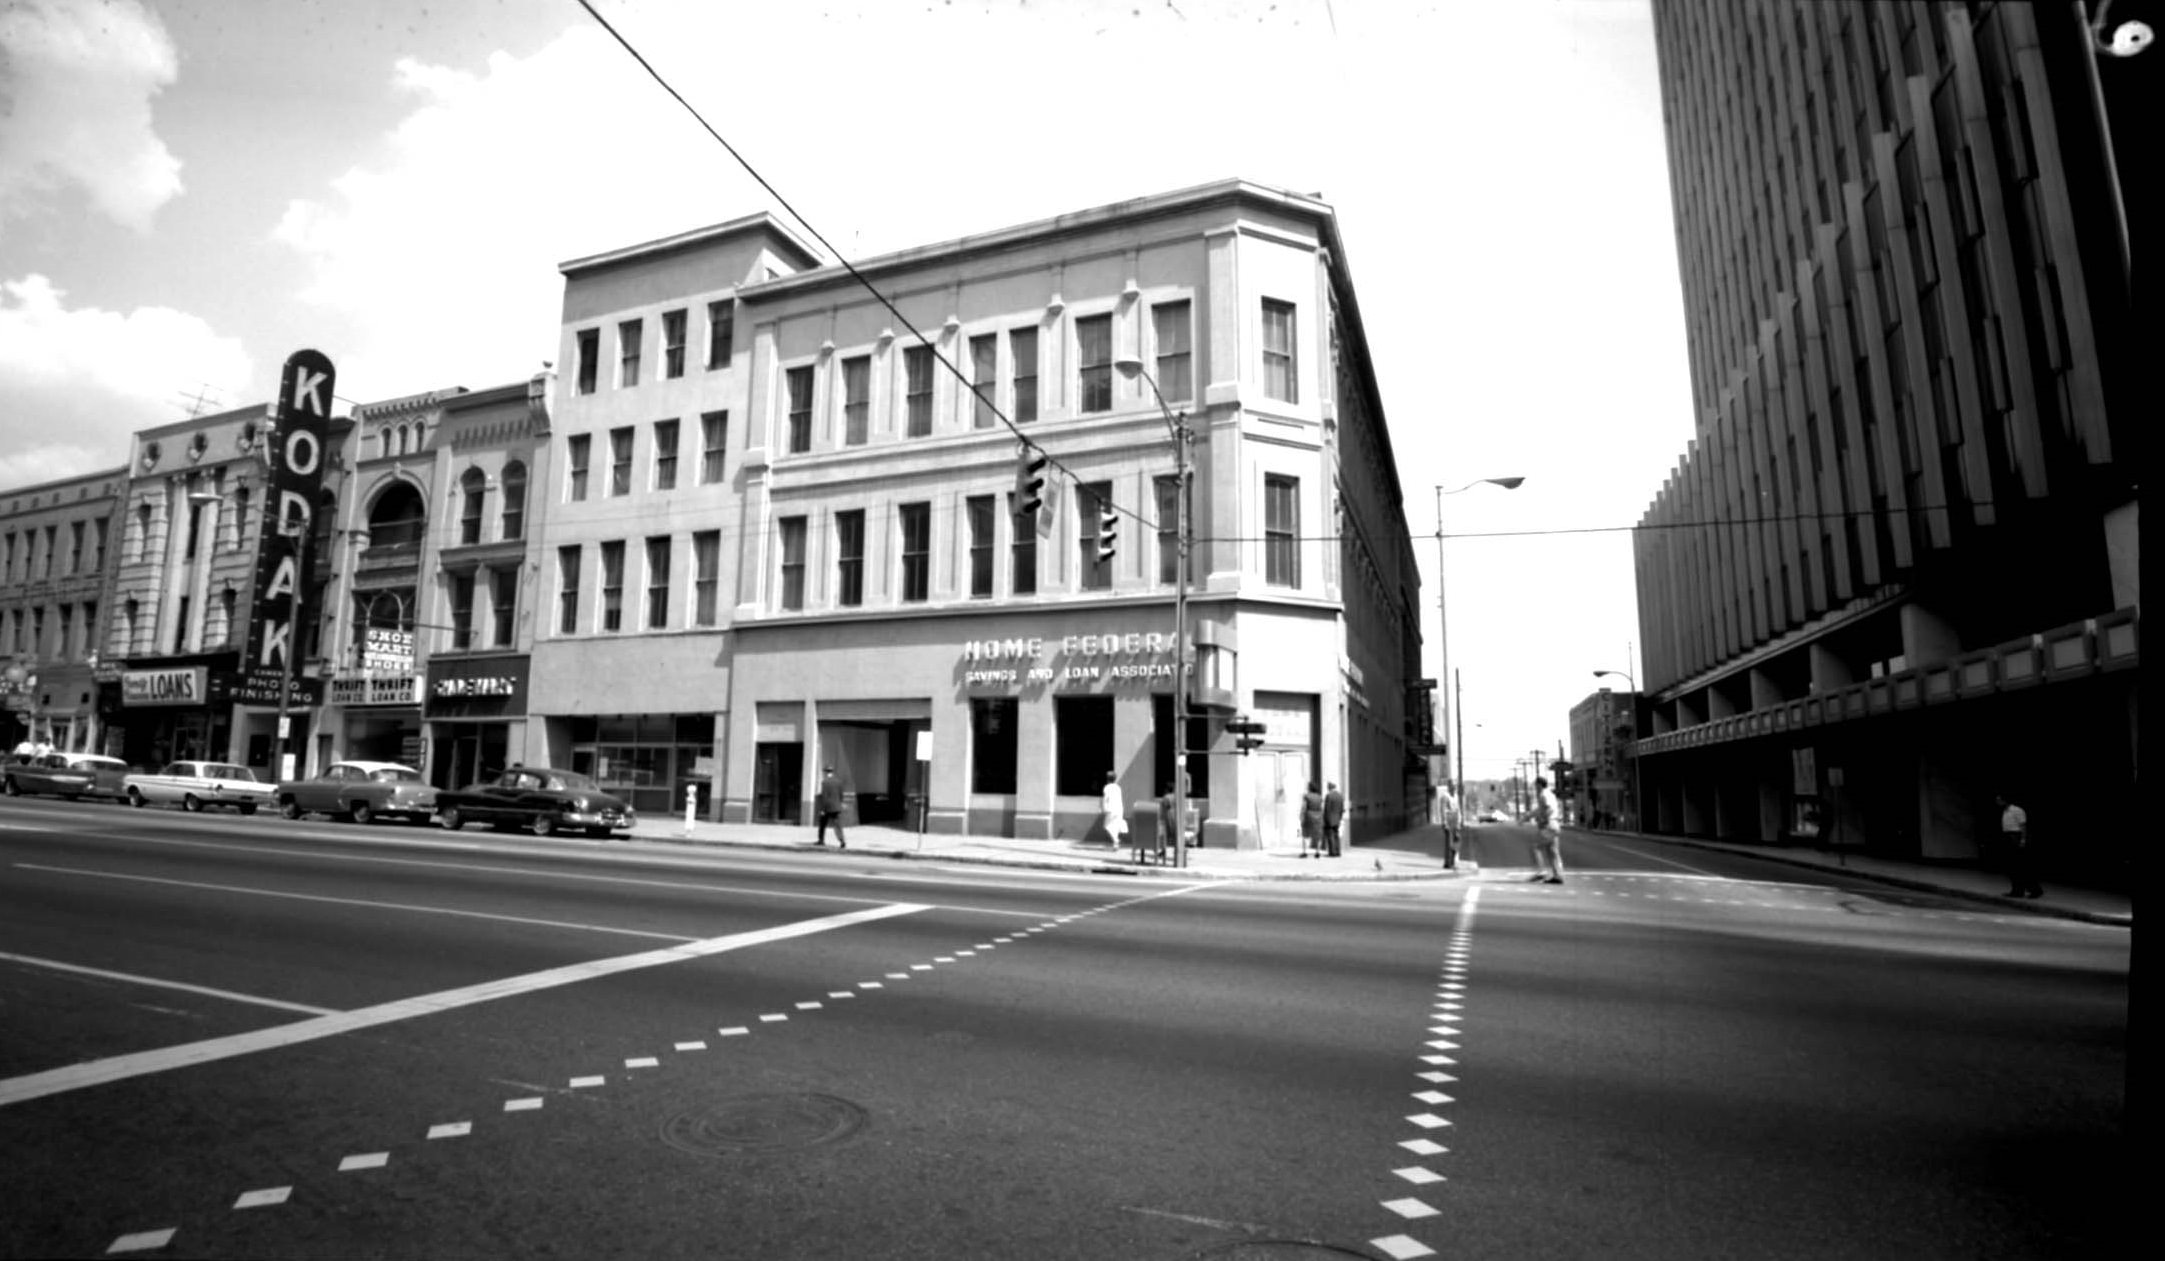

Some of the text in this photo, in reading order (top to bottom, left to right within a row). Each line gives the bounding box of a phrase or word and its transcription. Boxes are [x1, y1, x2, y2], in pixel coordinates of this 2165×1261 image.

[260, 365, 328, 667] KODAK
[367, 629, 413, 644] SHOE
[366, 641, 413, 655] MART
[965, 632, 1196, 661] HOME FEDERA
[965, 669, 1017, 681] SAVINGS
[1027, 668, 1053, 679] AND
[1065, 666, 1099, 679] LOAN
[150, 673, 193, 699] LOANS
[247, 678, 300, 691] PHOO
[371, 678, 414, 691] THRIFT
[229, 687, 313, 702] FINISHNG
[372, 692, 396, 702] LOAN
